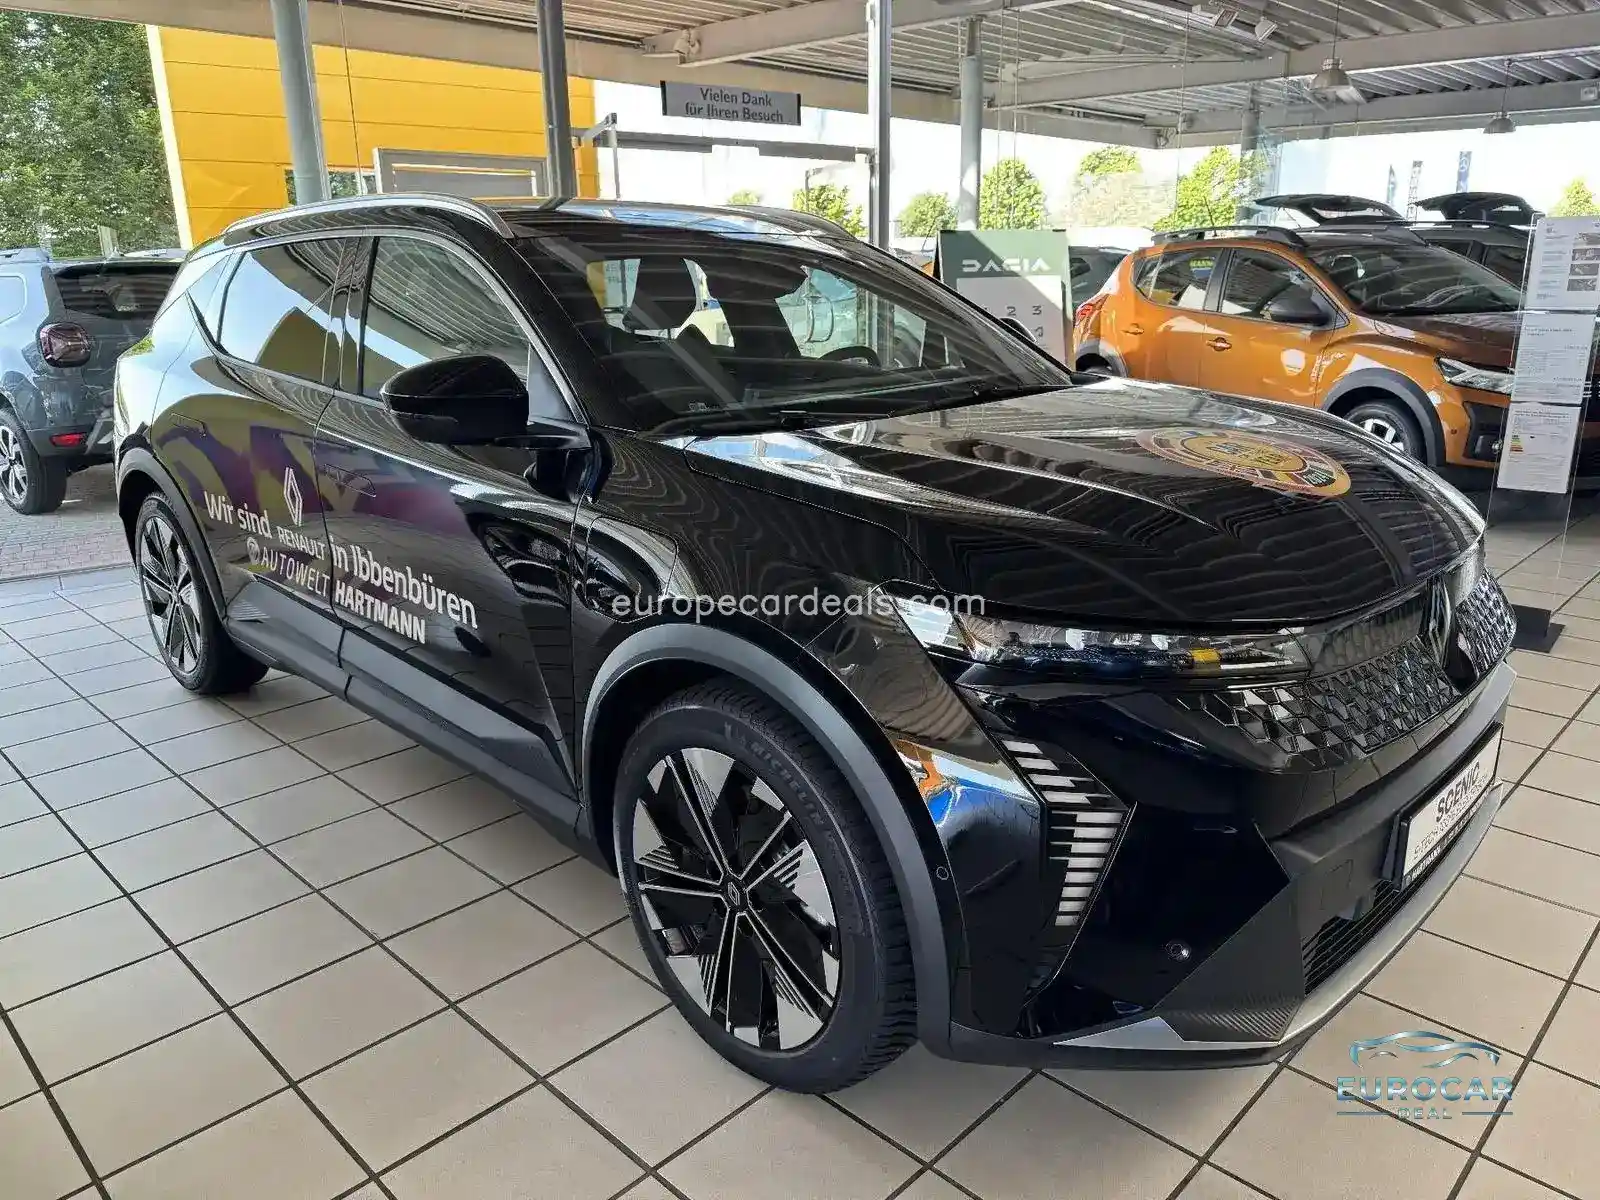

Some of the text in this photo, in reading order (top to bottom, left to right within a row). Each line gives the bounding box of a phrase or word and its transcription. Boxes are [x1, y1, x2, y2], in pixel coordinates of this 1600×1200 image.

[685, 101, 784, 123] für Ihren Besuch
[700, 87, 773, 108] Vielen Dank
[1006, 305, 1042, 317] 2 3
[203, 490, 479, 630] Wir sind in Ibbenbüren
[276, 525, 326, 561] RENAULT
[261, 546, 426, 645] AUTOWELT HARTMANN
[1436, 760, 1480, 823] SCENIC
